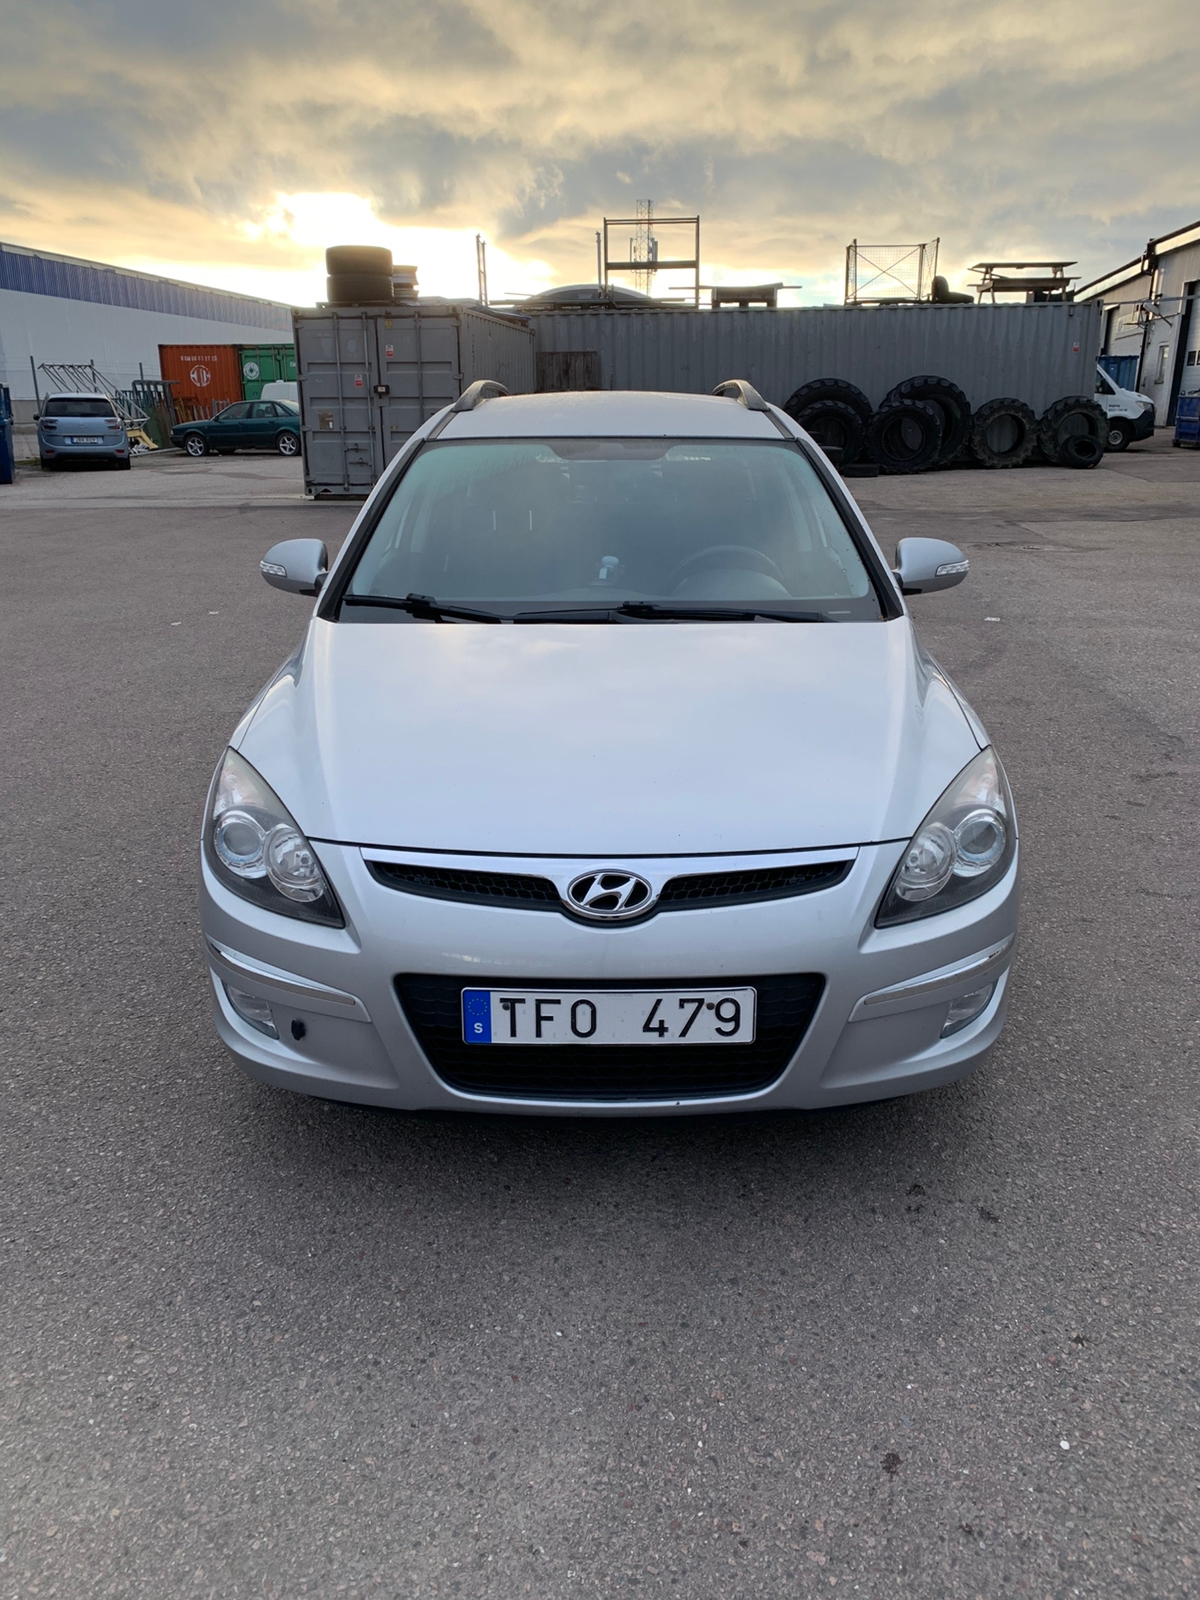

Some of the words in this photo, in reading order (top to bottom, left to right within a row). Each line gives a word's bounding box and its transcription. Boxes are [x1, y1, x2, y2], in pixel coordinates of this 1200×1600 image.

[474, 1022, 483, 1034] S
[499, 997, 597, 1038] TFO
[642, 997, 741, 1037] 479
